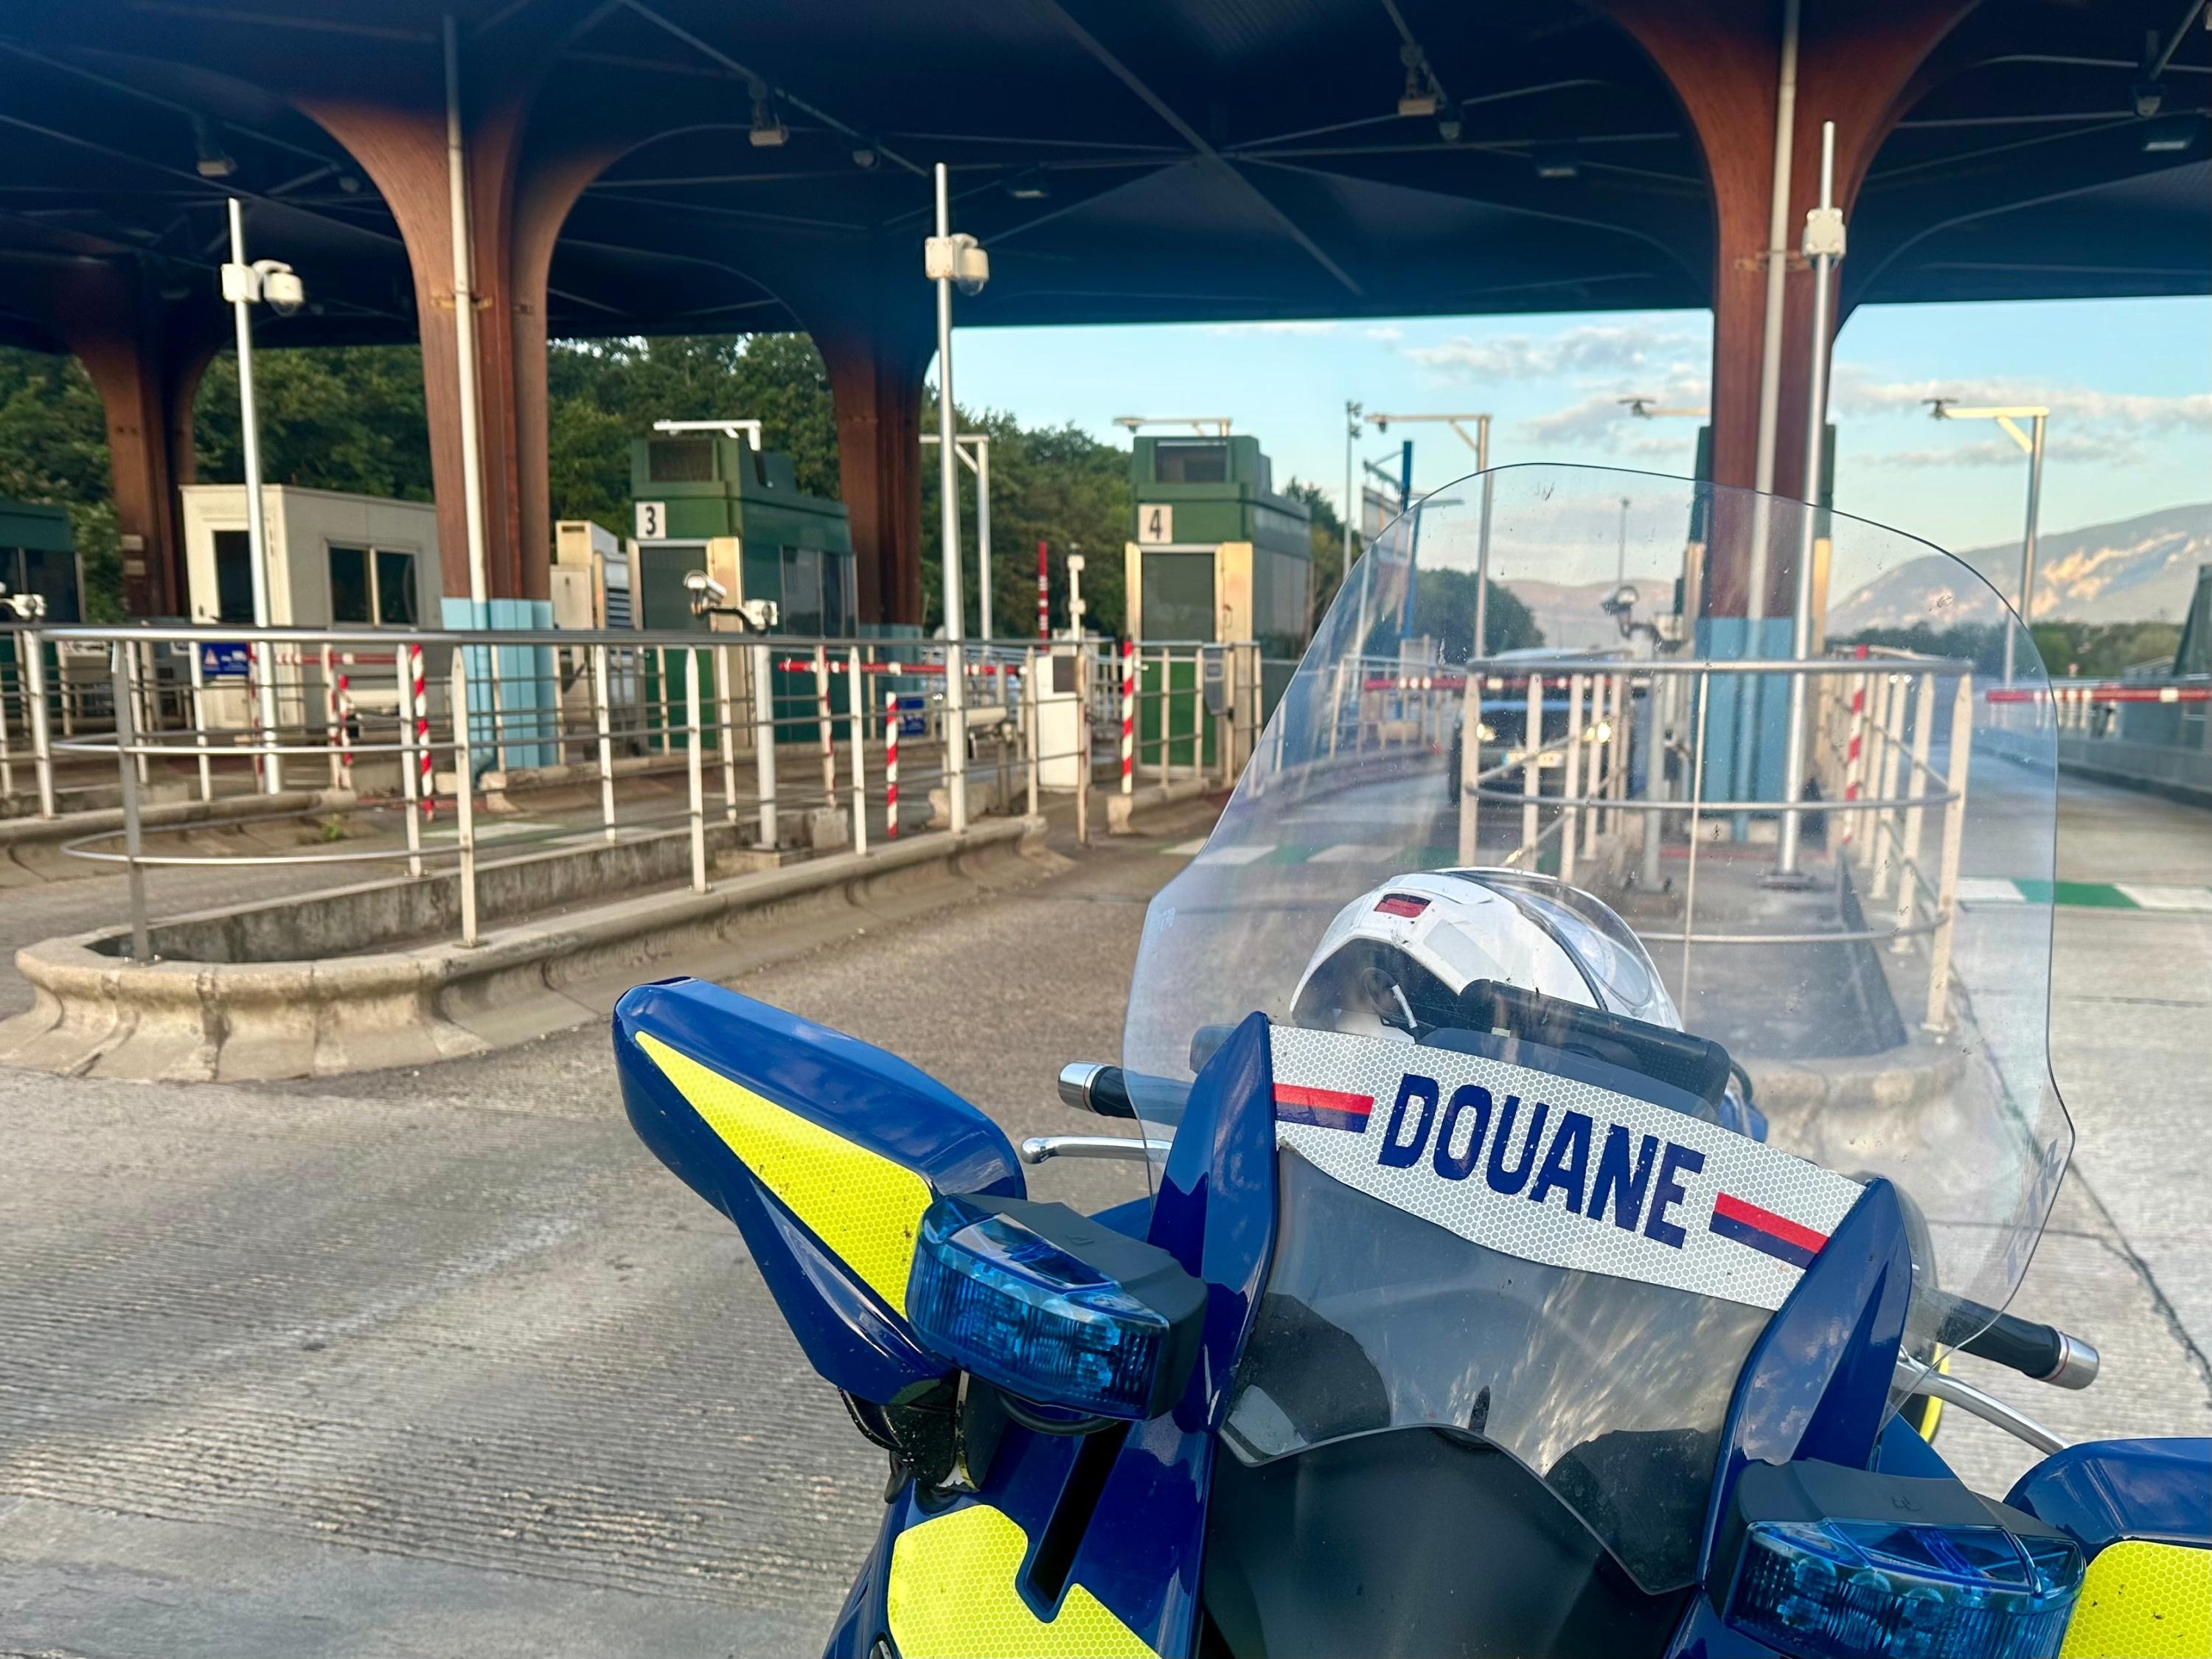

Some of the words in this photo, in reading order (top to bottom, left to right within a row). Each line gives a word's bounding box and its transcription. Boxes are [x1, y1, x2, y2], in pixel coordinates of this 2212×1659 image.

[646, 506, 656, 535] 3
[1150, 509, 1162, 539] 4
[1378, 1073, 1705, 1249] DOUANE
